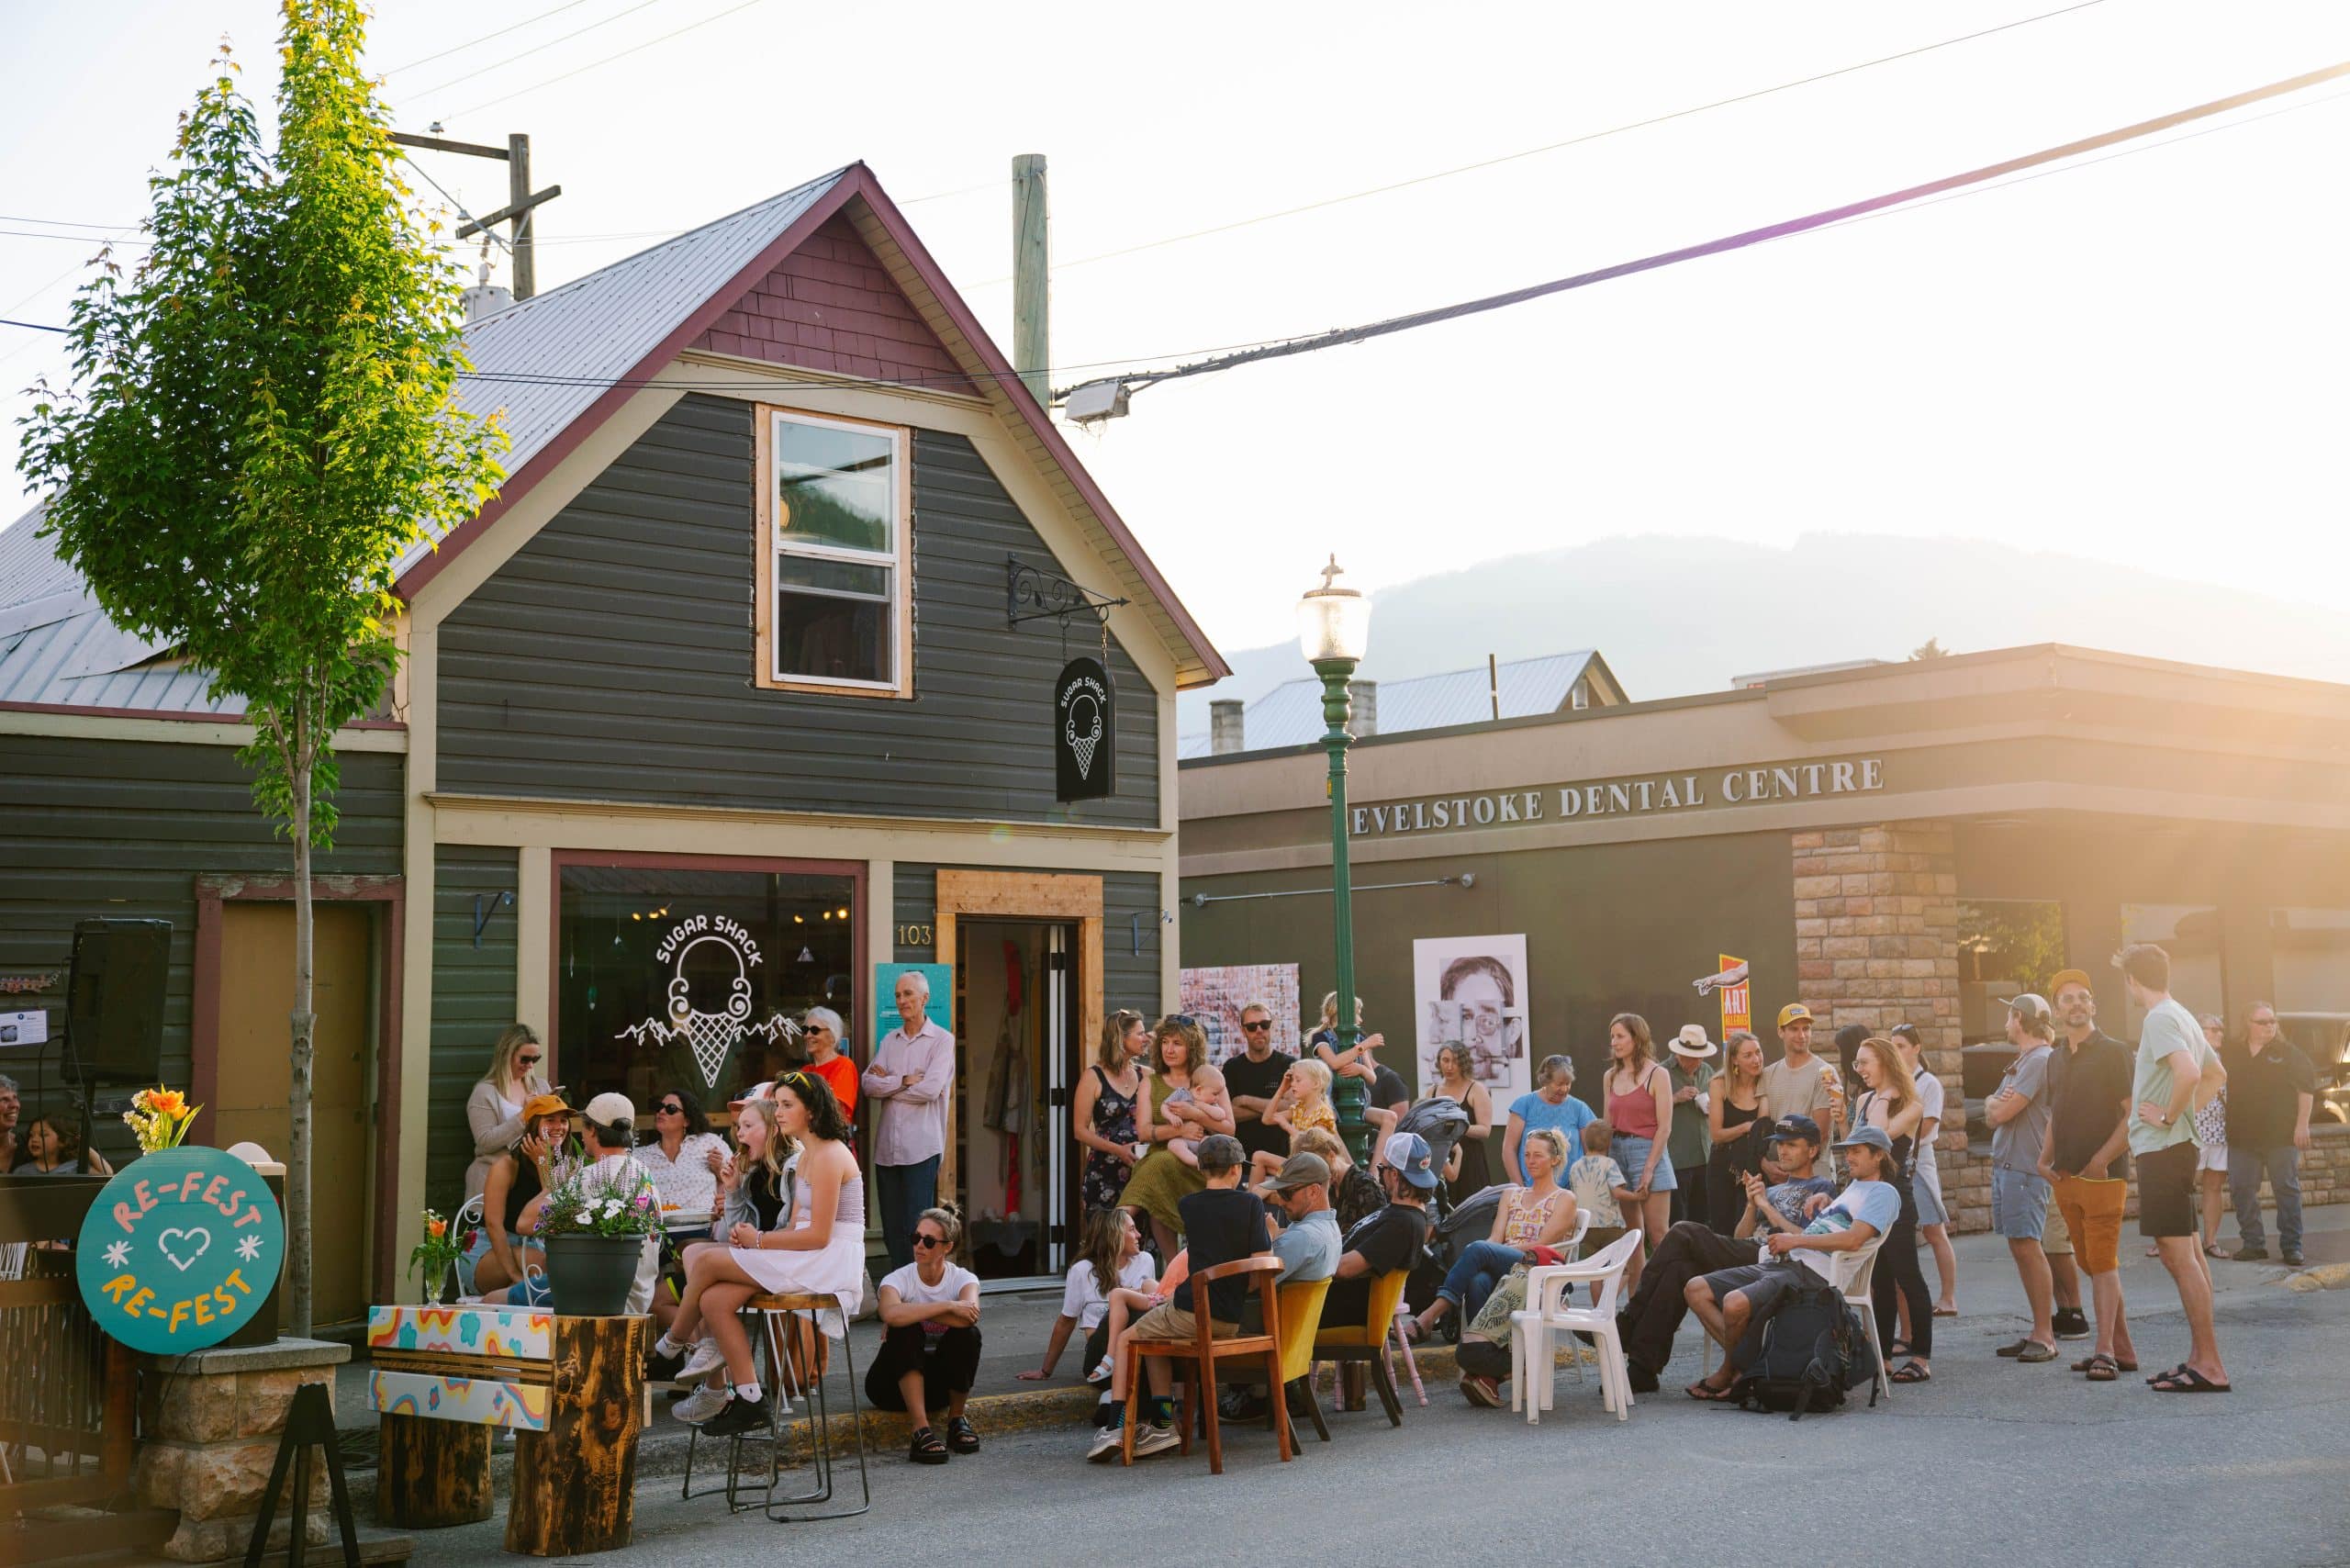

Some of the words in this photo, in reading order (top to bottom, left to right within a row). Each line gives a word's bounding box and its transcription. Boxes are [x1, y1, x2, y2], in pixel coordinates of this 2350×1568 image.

[1060, 677, 1083, 709] SUGAR
[1084, 677, 1107, 704] SHACK
[1348, 791, 1543, 835] EVELSTOKE
[1559, 776, 1704, 817] DENTAL
[1722, 759, 1885, 803] CENTRE
[655, 914, 709, 964] SUGAR
[713, 915, 764, 967] SHACK
[898, 924, 932, 946] 103
[1724, 989, 1747, 1014] ART
[113, 1171, 263, 1234] RE-FEST
[102, 1268, 252, 1335] RE-FEST
